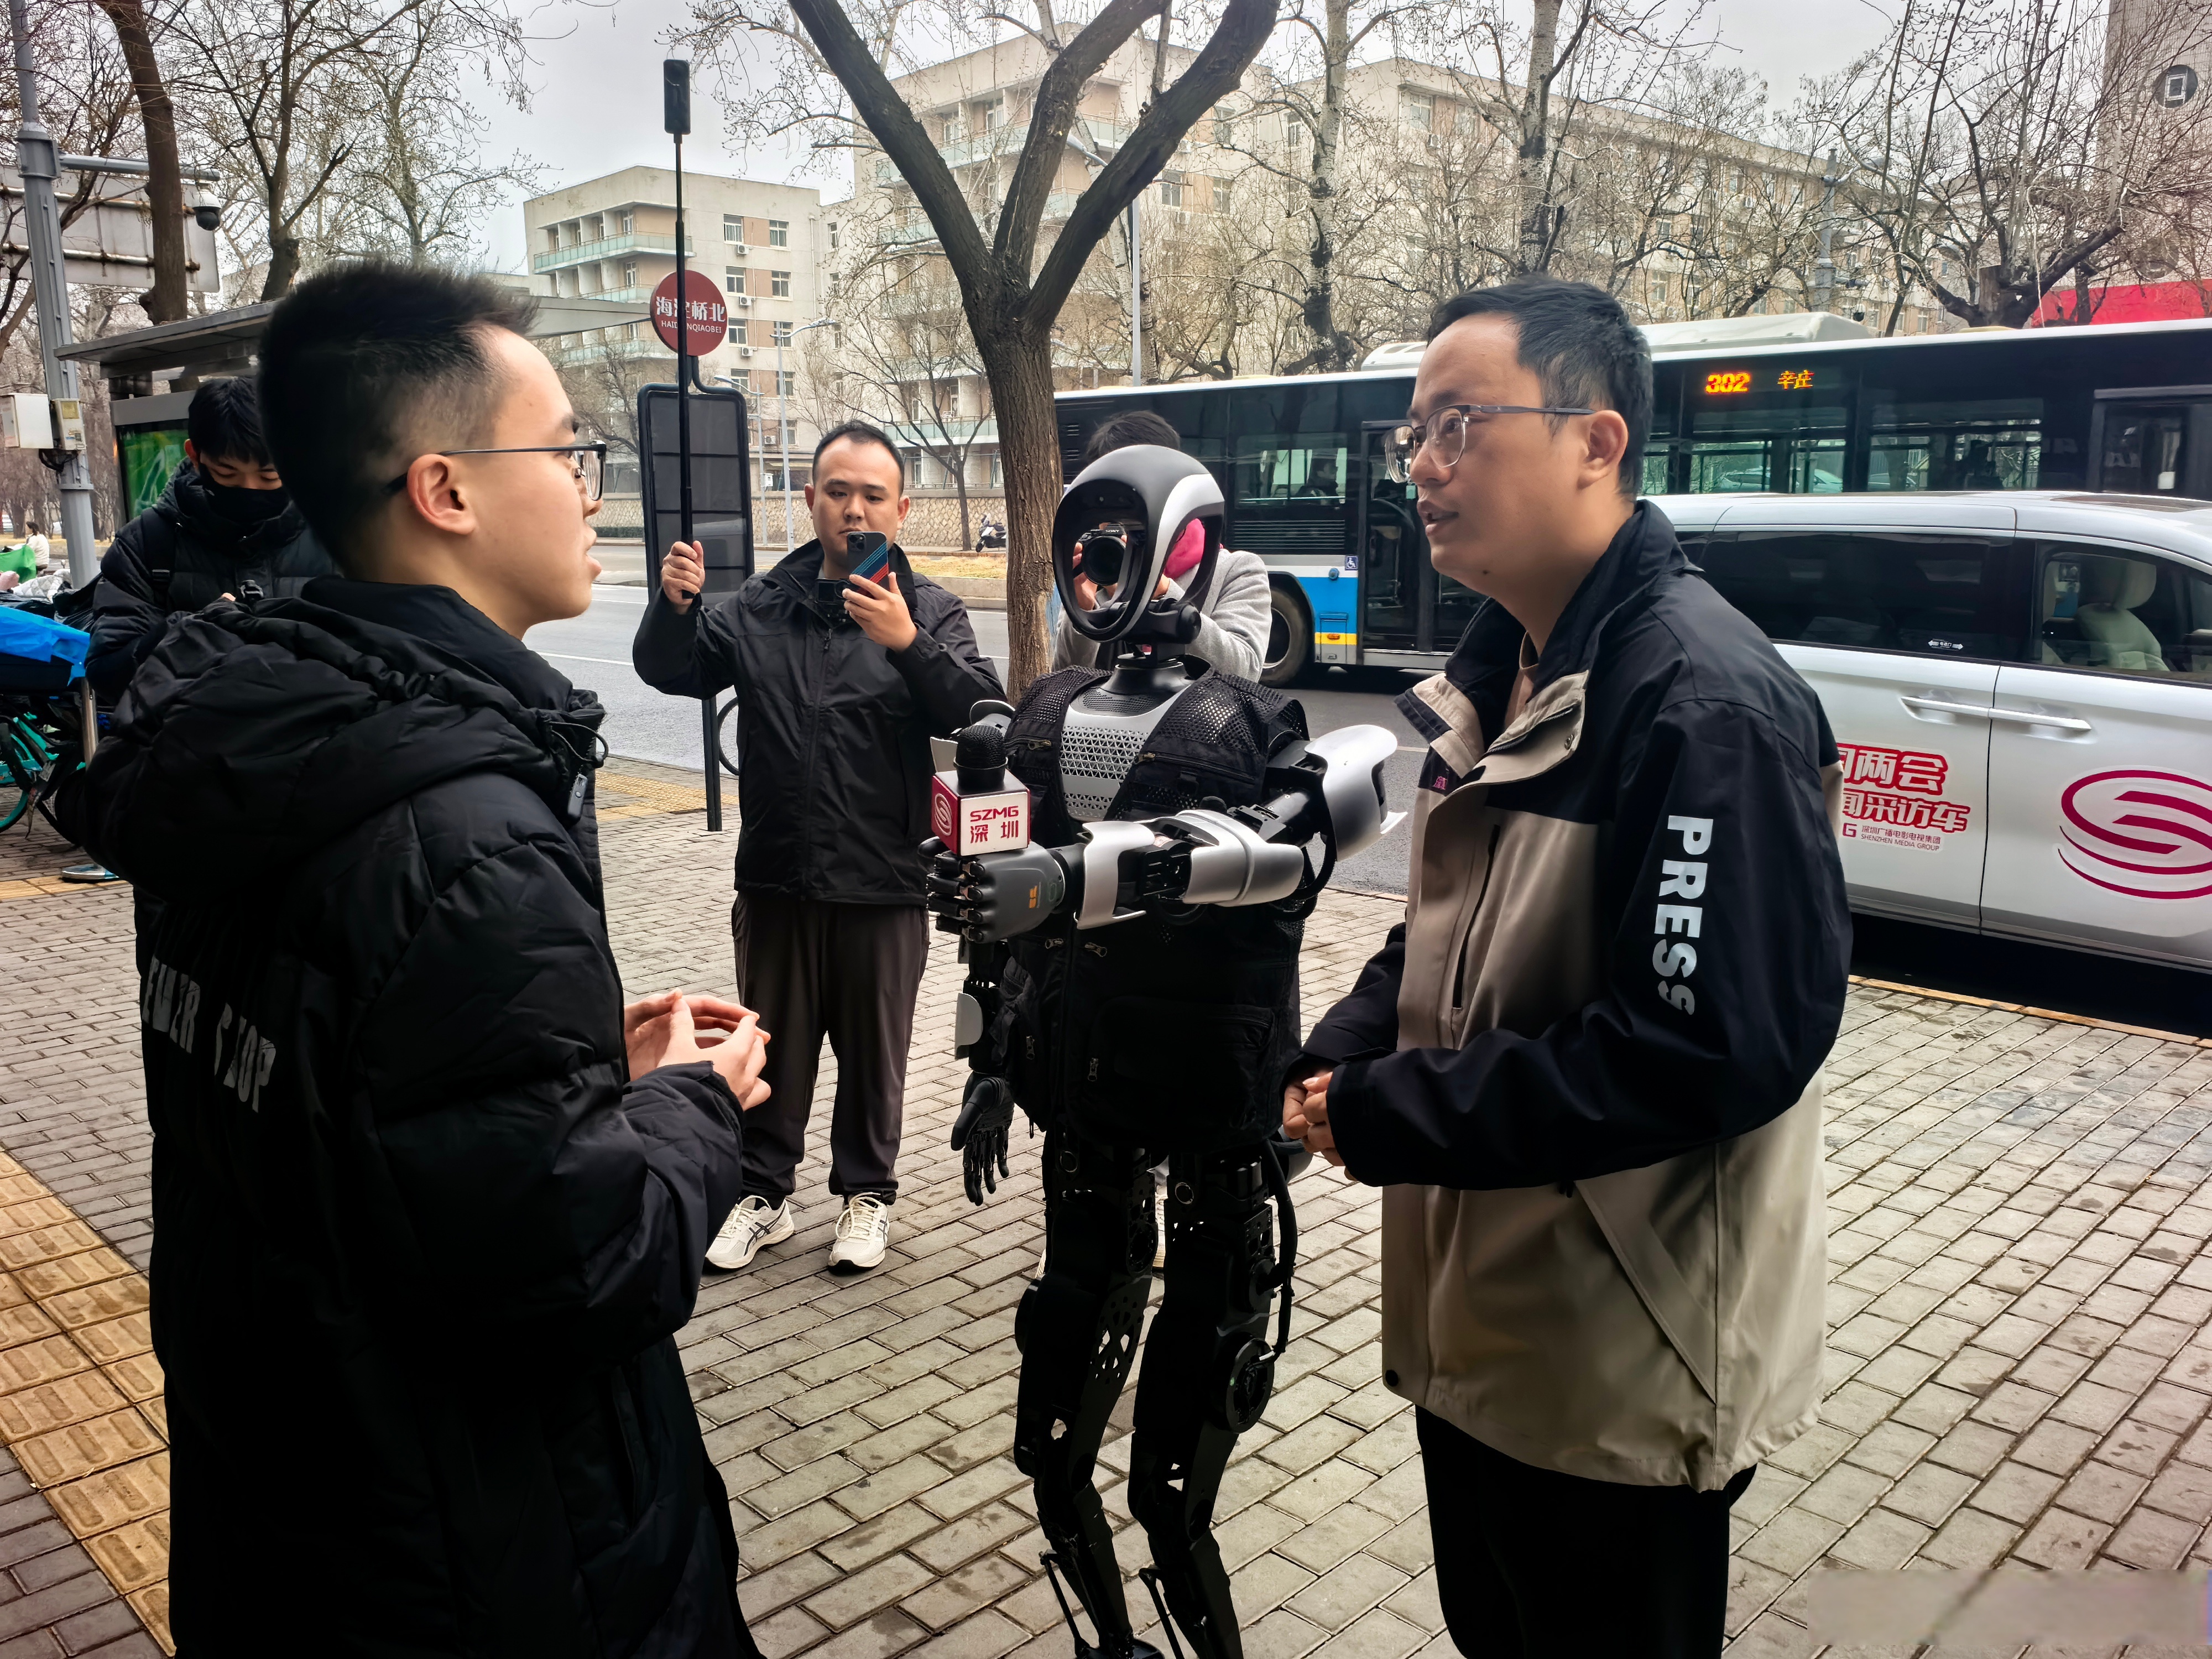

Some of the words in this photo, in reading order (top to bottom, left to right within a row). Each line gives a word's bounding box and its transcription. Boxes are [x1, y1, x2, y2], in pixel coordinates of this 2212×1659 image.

[661, 320, 722, 333] HAIDNQIAOBEI
[1705, 372, 1750, 394] 302
[1777, 369, 1814, 390] 辛庄
[970, 805, 1019, 822] SZMG
[970, 820, 1019, 844] 深圳
[1861, 833, 1893, 844] SHENZHEN
[1895, 839, 1915, 848] MEDIA
[1917, 842, 1940, 851] GROUP
[1652, 815, 1714, 1015] PRESS
